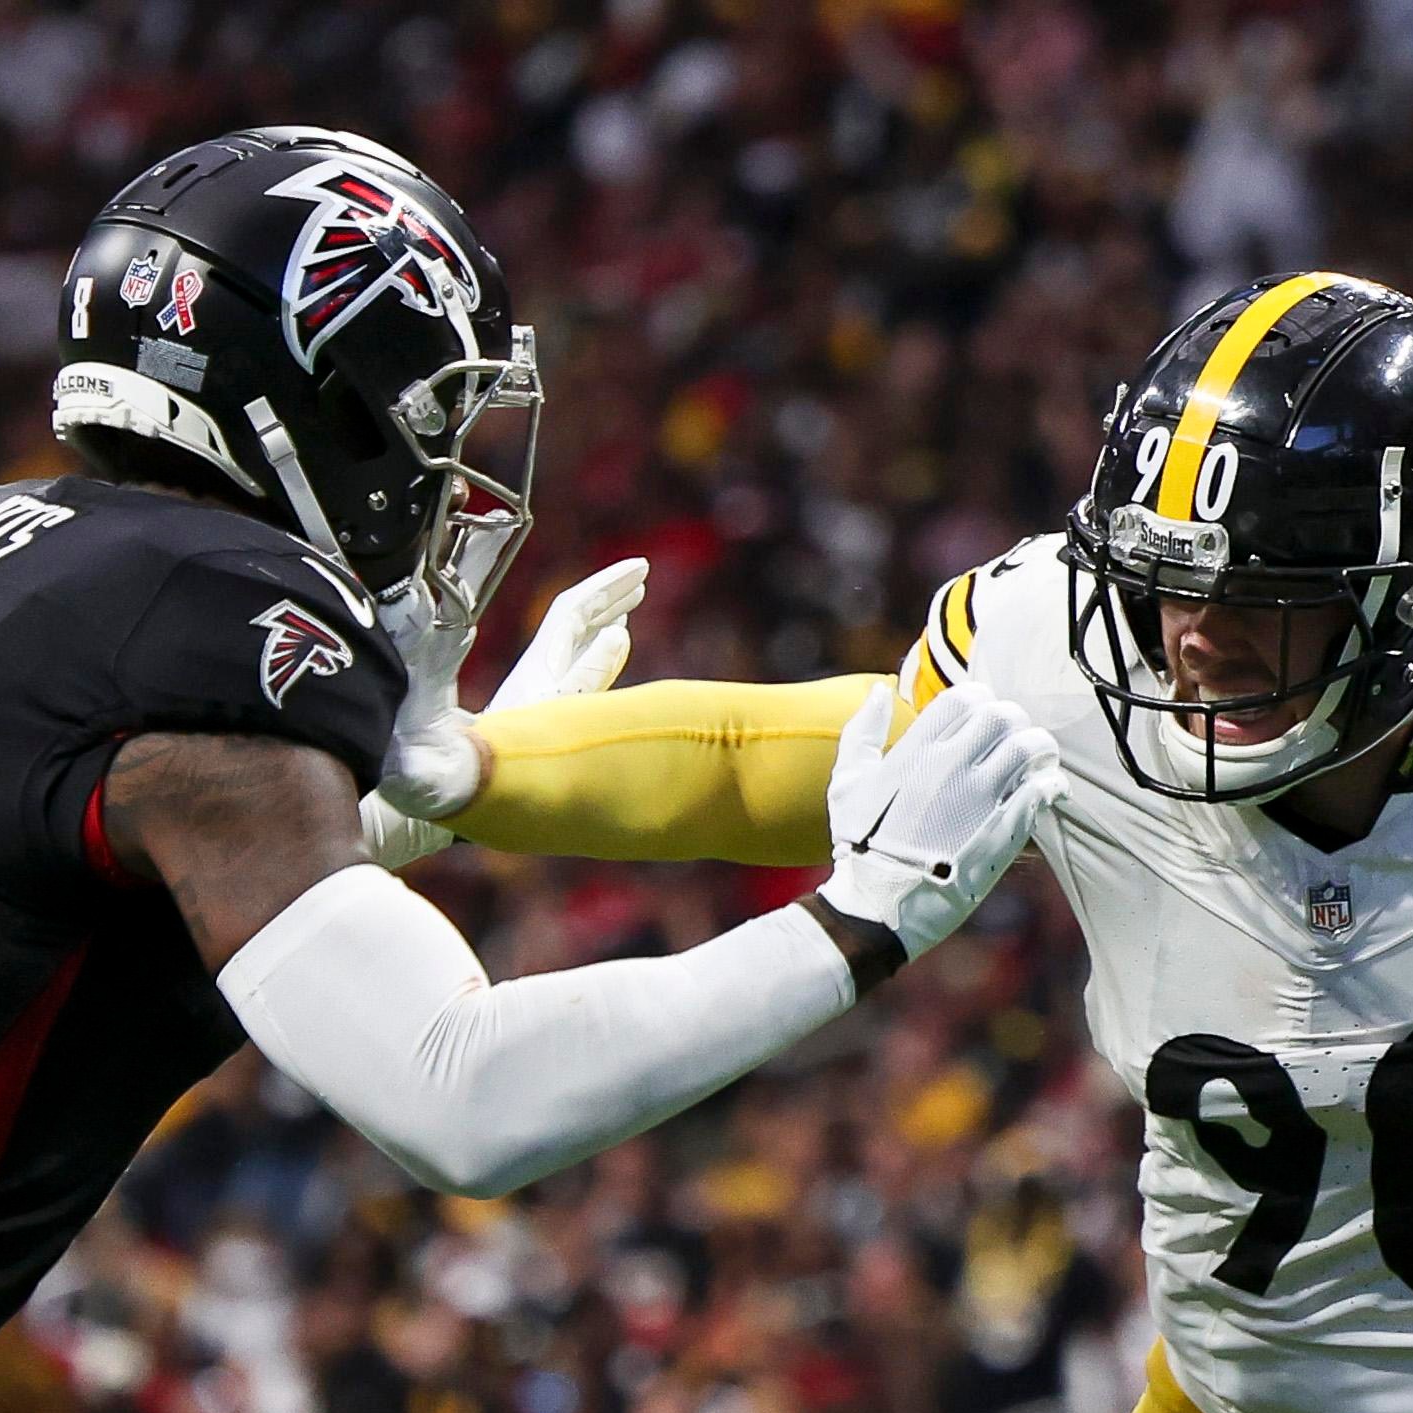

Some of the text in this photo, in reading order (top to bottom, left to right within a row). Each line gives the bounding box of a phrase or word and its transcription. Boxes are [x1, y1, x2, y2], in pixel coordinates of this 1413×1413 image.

[123, 276, 152, 299] NFL
[57, 375, 110, 393] LCONS
[1131, 425, 1239, 522] 90
[1311, 901, 1350, 927] NFL
